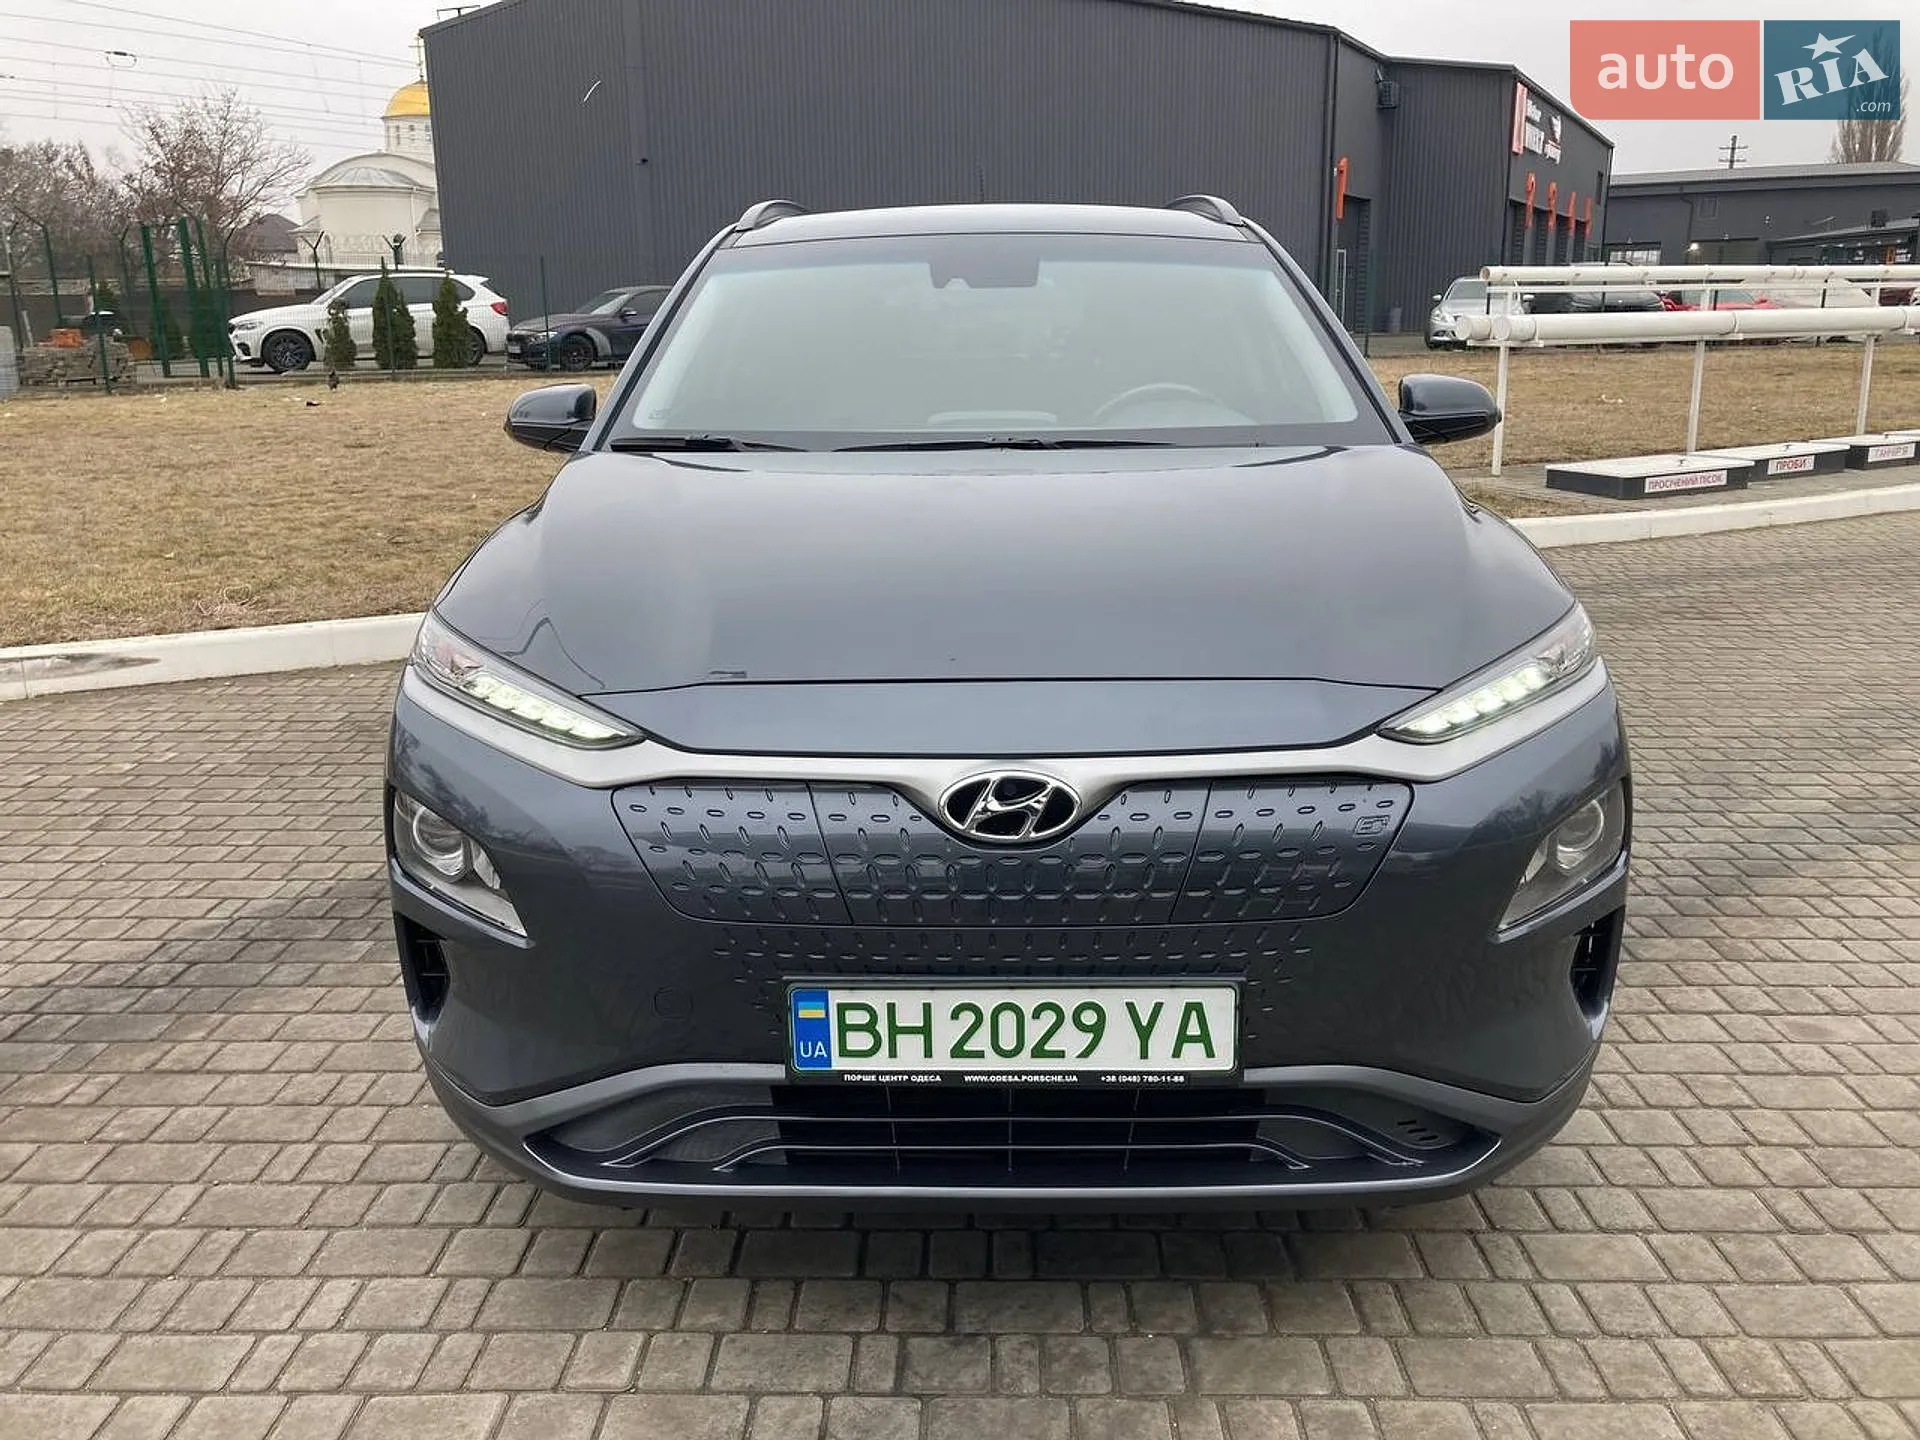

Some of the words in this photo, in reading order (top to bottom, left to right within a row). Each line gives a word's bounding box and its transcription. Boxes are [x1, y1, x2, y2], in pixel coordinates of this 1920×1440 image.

[836, 1002, 933, 1059] BH
[950, 1001, 1107, 1059] 2029
[1125, 1001, 1216, 1059] YA
[800, 1041, 827, 1058] UA
[844, 1074, 877, 1082] ПОРШЕ
[879, 1074, 909, 1083] ЦЕНТР
[911, 1075, 942, 1083] ОДЕСА
